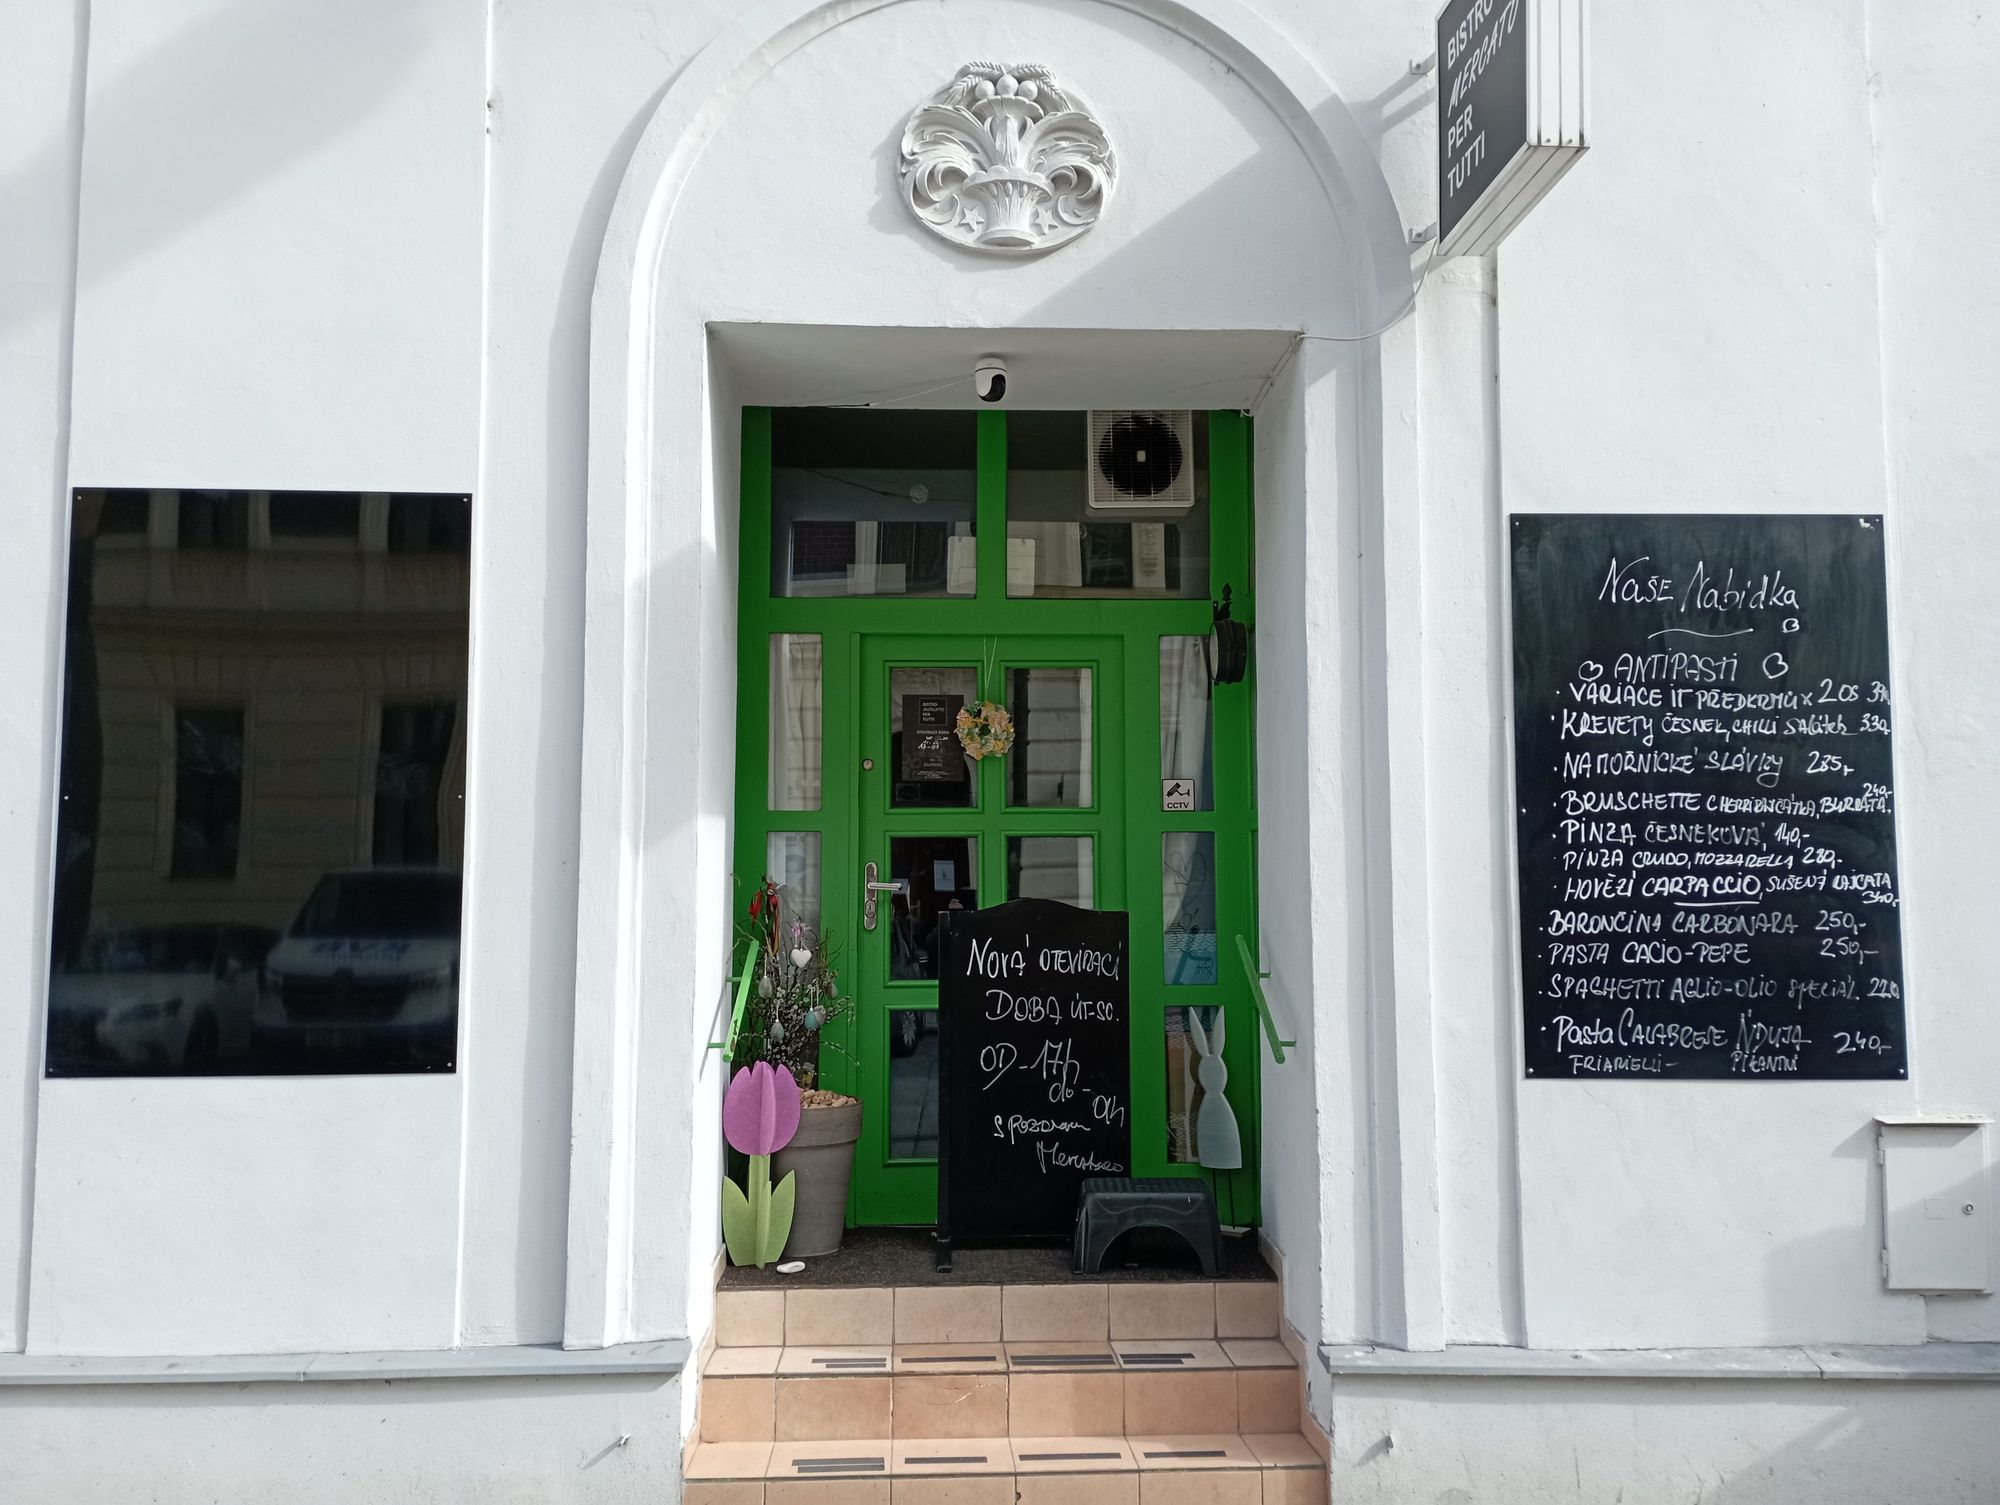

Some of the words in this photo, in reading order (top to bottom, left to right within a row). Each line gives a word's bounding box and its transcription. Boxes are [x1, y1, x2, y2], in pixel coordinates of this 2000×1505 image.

[1447, 104, 1473, 158] PER
[1447, 130, 1485, 198] TUTTI
[1166, 801, 1190, 810] CCTV
[1560, 790, 1702, 815] BRUSCHETTE
[1548, 942, 1610, 966] PASTA
[1547, 973, 1666, 1000] SPAGHETTI
[985, 989, 1063, 1025] DOBA
